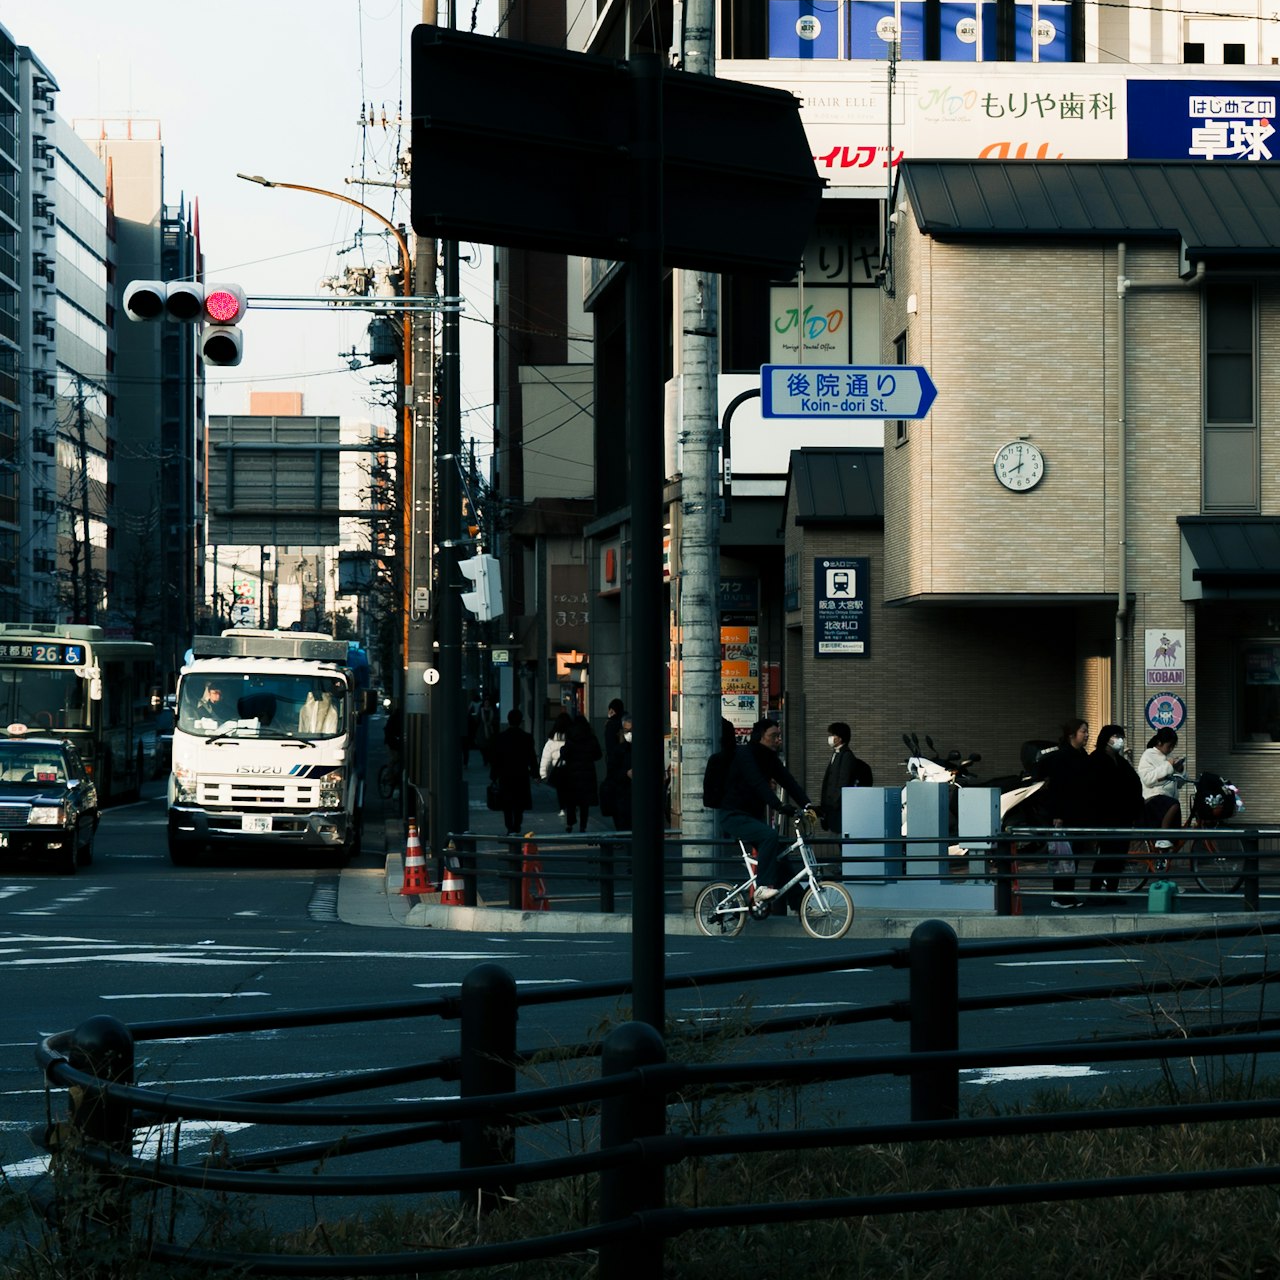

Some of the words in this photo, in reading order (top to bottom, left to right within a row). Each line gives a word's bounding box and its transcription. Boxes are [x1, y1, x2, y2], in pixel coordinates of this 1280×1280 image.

[807, 98, 840, 108] HAIR
[845, 98, 876, 108] ELLE
[980, 92, 1117, 120] もりや歯科
[1193, 99, 1273, 116] はじめての
[1188, 119, 1276, 160] 卓球
[786, 372, 897, 398] 後院通り
[870, 398, 888, 413] St.
[240, 606, 251, 614] P
[819, 600, 837, 610] 阪急
[838, 600, 864, 610] 大宮駅
[824, 621, 859, 631] 北改札口
[35, 646, 57, 662] 26
[1148, 671, 1182, 683] KOBAN
[236, 766, 282, 774] ISUZU
